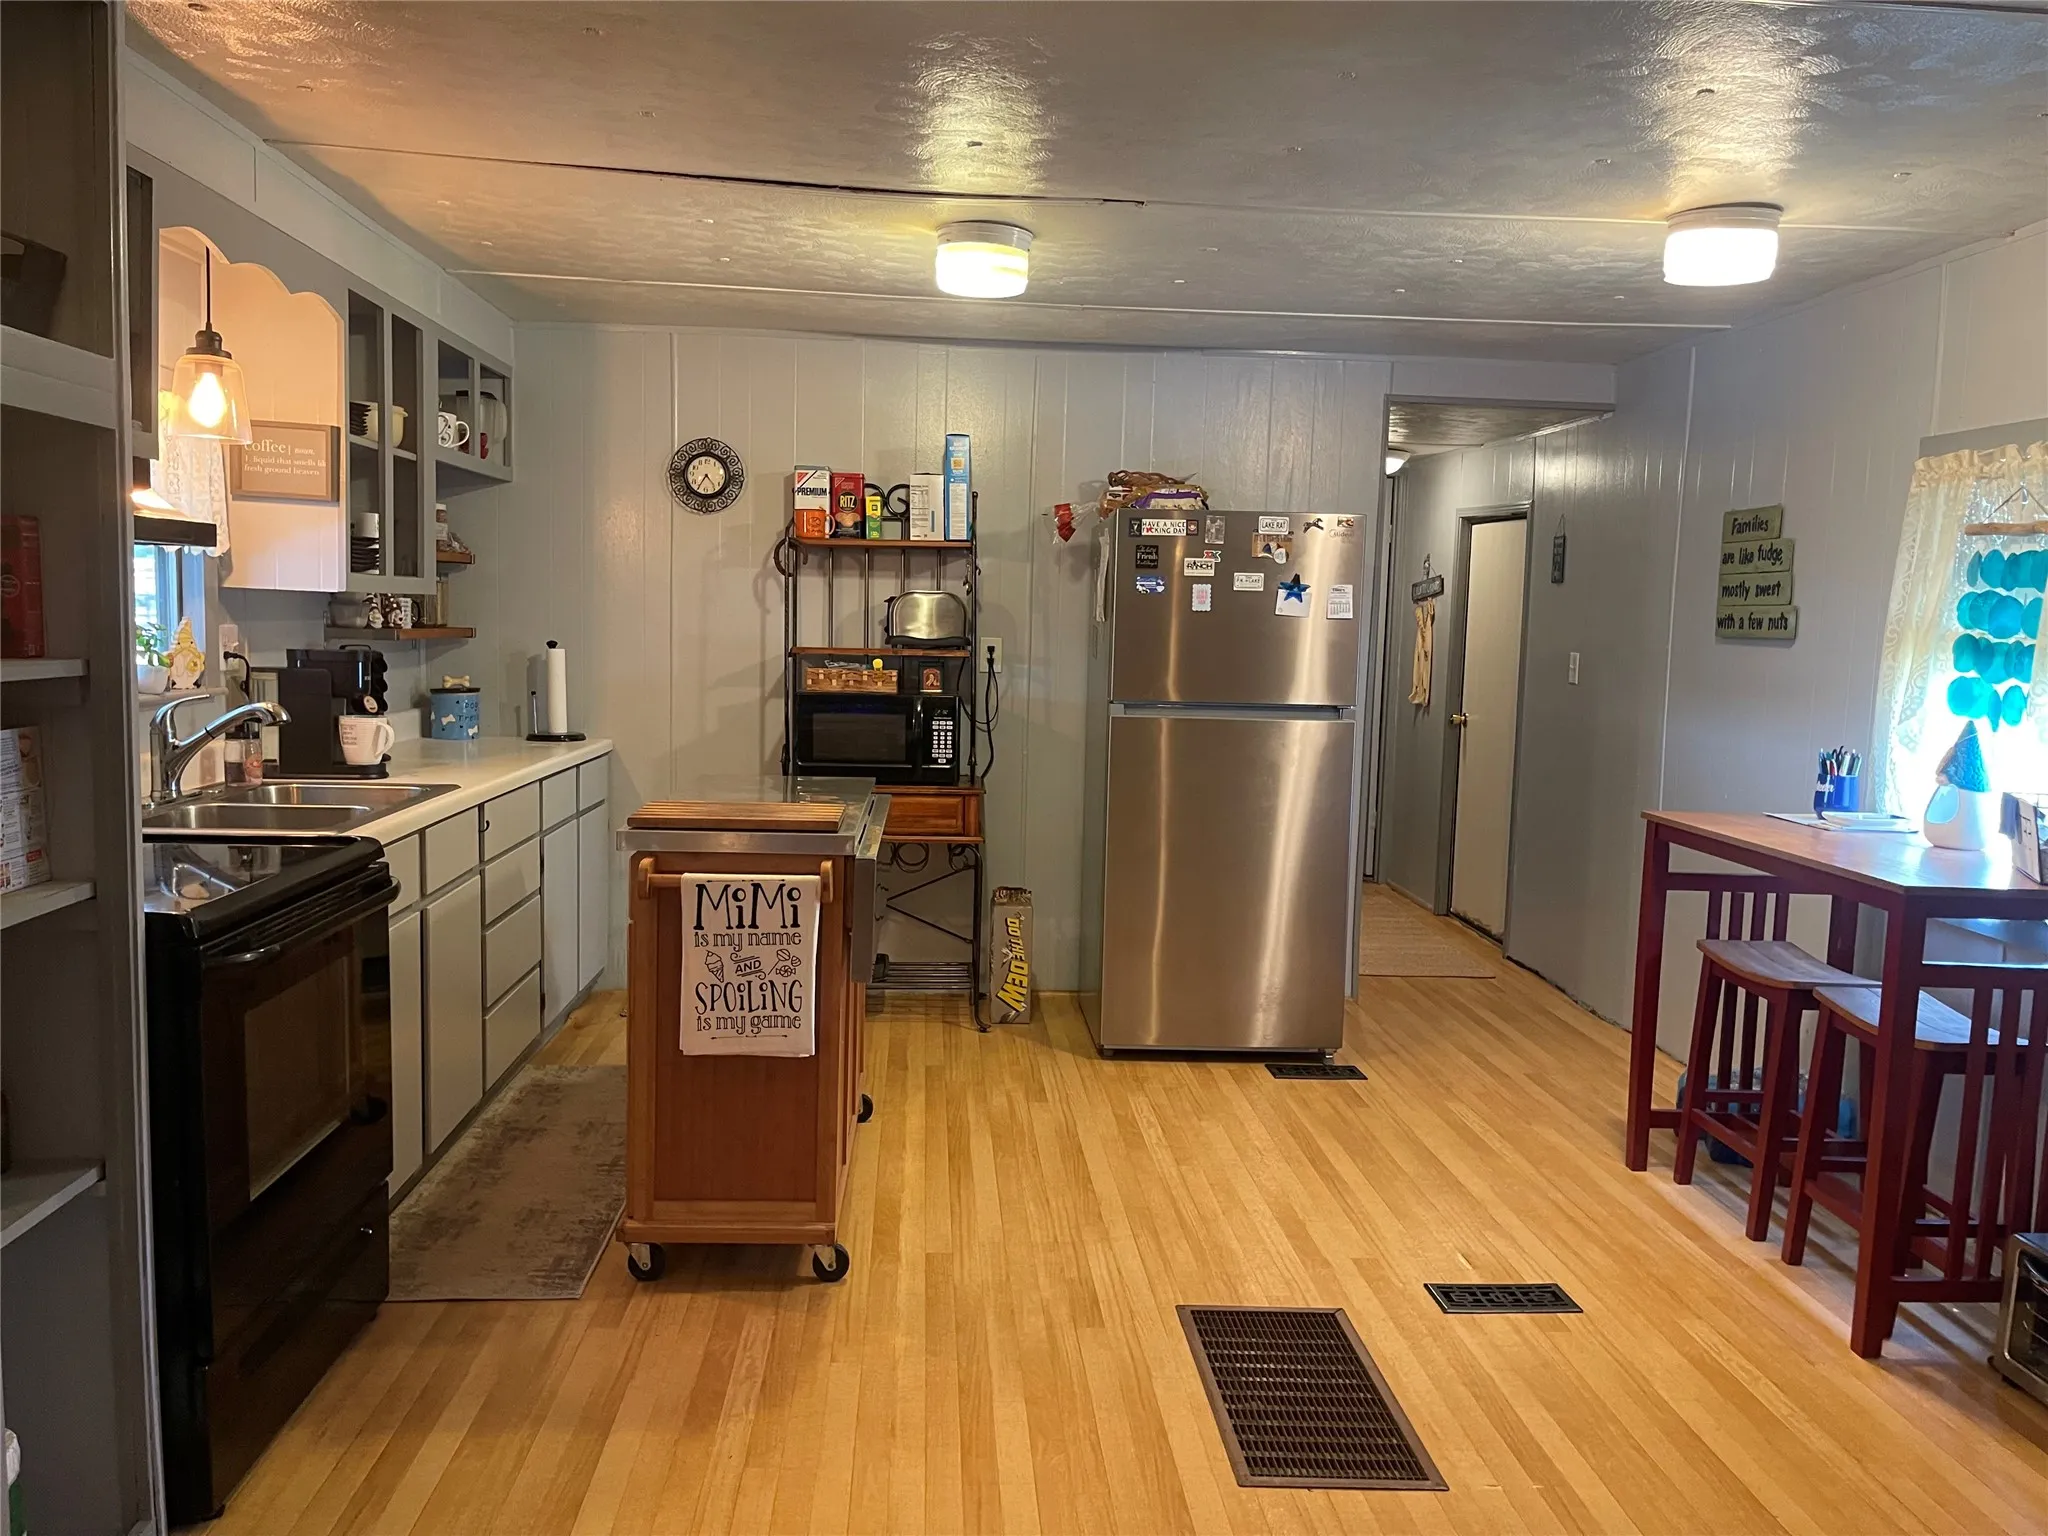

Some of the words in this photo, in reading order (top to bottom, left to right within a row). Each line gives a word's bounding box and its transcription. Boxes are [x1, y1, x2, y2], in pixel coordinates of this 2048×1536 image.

[244, 439, 286, 453] coffee
[244, 464, 263, 472] fresh
[264, 466, 292, 475] ground
[253, 456, 275, 465] liquid
[276, 457, 292, 465] that
[796, 487, 828, 496] PREMIUM
[839, 494, 856, 508] RITZ
[1276, 521, 1286, 529] RAT
[1731, 514, 1769, 536] Families
[1722, 551, 1735, 565] are
[1738, 547, 1755, 565] like
[1721, 580, 1751, 601] mostly
[1755, 580, 1781, 598] sweet
[1716, 613, 1735, 629] with
[1738, 619, 1744, 630] a
[1748, 612, 1764, 630] few
[1767, 611, 1788, 631] nuts
[1005, 917, 1021, 937] DO
[693, 932, 709, 948] is
[713, 932, 743, 952] my
[747, 932, 801, 946] name
[1009, 937, 1025, 962] THE
[734, 960, 762, 974] AND
[996, 960, 1029, 1012] DEW
[696, 1016, 712, 1032] is
[715, 1016, 745, 1035] my
[750, 1014, 801, 1034] game
